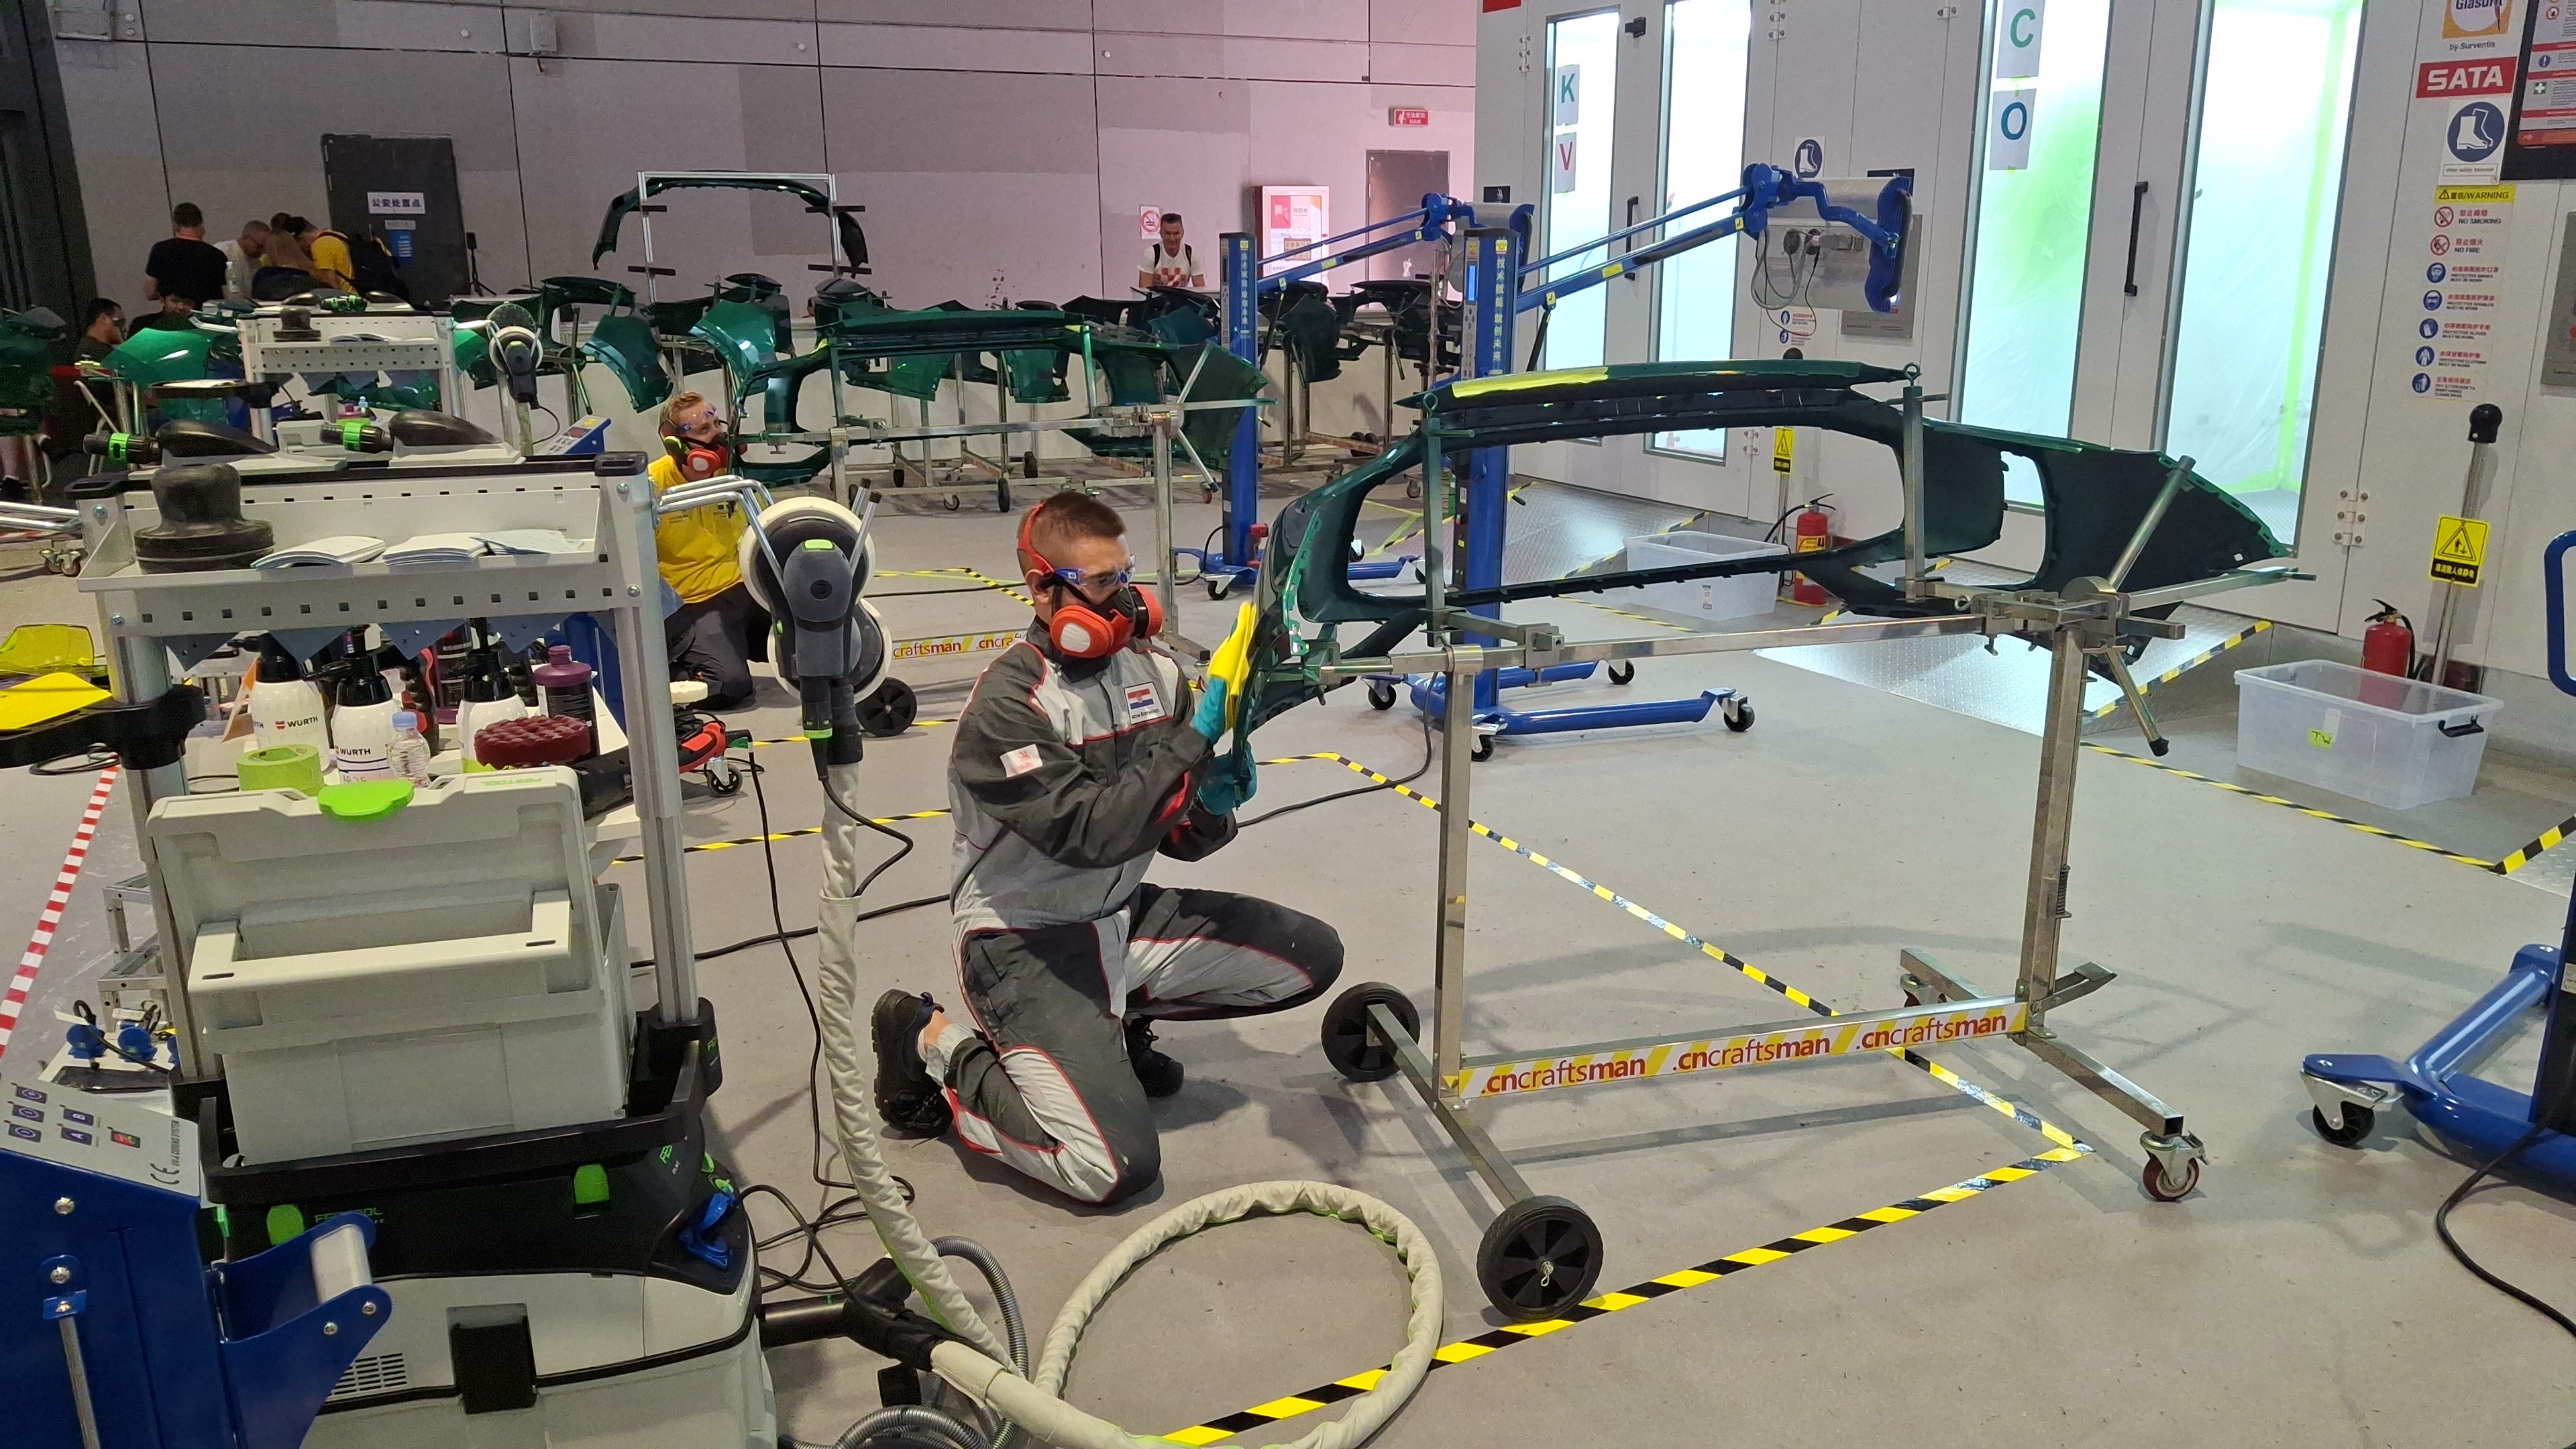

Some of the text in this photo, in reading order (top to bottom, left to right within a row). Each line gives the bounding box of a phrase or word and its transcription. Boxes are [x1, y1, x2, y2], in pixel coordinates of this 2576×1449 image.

[2010, 8, 2036, 48] C
[2449, 44, 2459, 52] by
[1560, 73, 1576, 103] K
[2426, 65, 2504, 91] SATA
[1559, 141, 1573, 170] V
[1481, 1014, 2007, 1094] .cncraftsman .cncraftsman .cncraftsman
